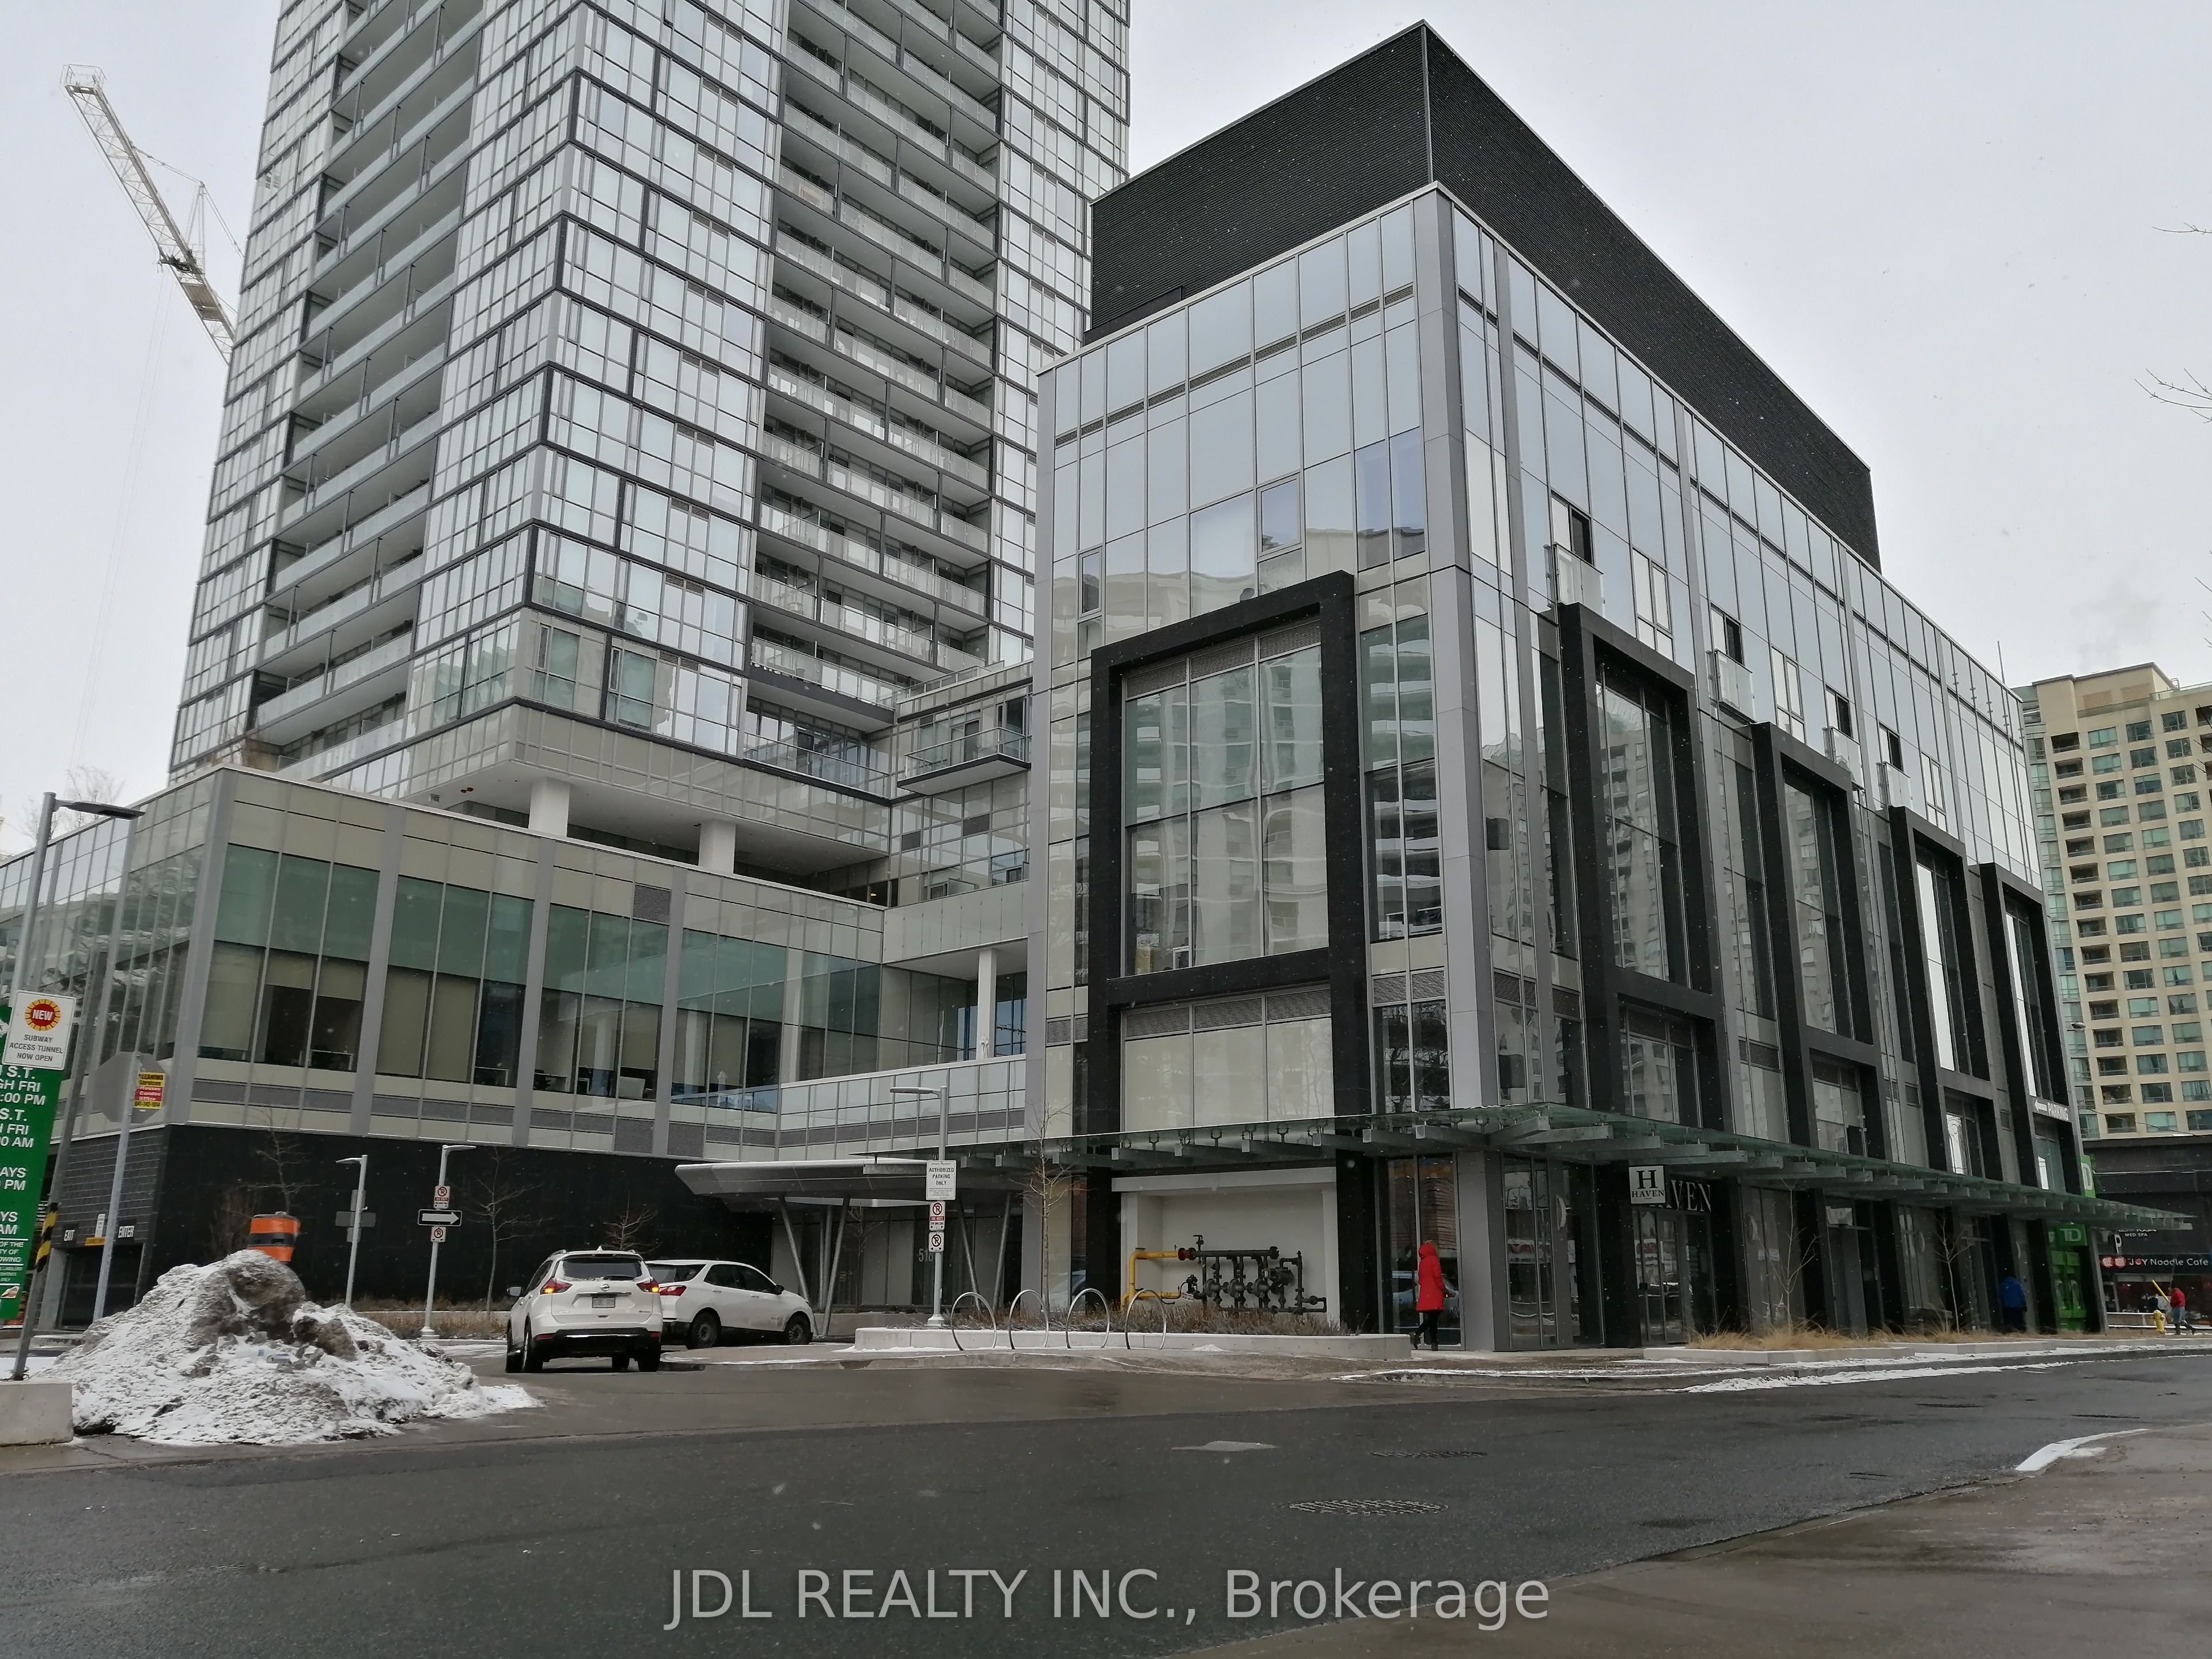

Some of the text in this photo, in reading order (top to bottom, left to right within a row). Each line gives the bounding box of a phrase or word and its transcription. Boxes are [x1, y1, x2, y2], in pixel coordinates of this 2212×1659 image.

[32, 1009, 53, 1021] NEW
[24, 1034, 53, 1043] SUBWAY
[9, 1042, 63, 1054] ACCESS TUNNEL
[6, 1066, 36, 1080] S.T.
[18, 1081, 41, 1092] FRI
[24, 1094, 46, 1105] PM
[0, 1108, 28, 1122] S.T.
[2047, 1101, 2069, 1121] PARKING
[6, 1123, 29, 1135] FRI
[12, 1137, 34, 1148] AM
[4, 1179, 26, 1191] PM
[1636, 1169, 1658, 1189] H
[1631, 1190, 1665, 1198] HAVEN
[1658, 1180, 1712, 1213] VEN
[64, 1229, 75, 1241] EXIT
[118, 1225, 134, 1238] ENTER
[2059, 1229, 2082, 1242] TD
[2114, 1234, 2122, 1254] P
[2150, 1258, 2183, 1266] Noodle
[2187, 1257, 2209, 1266] Cafe
